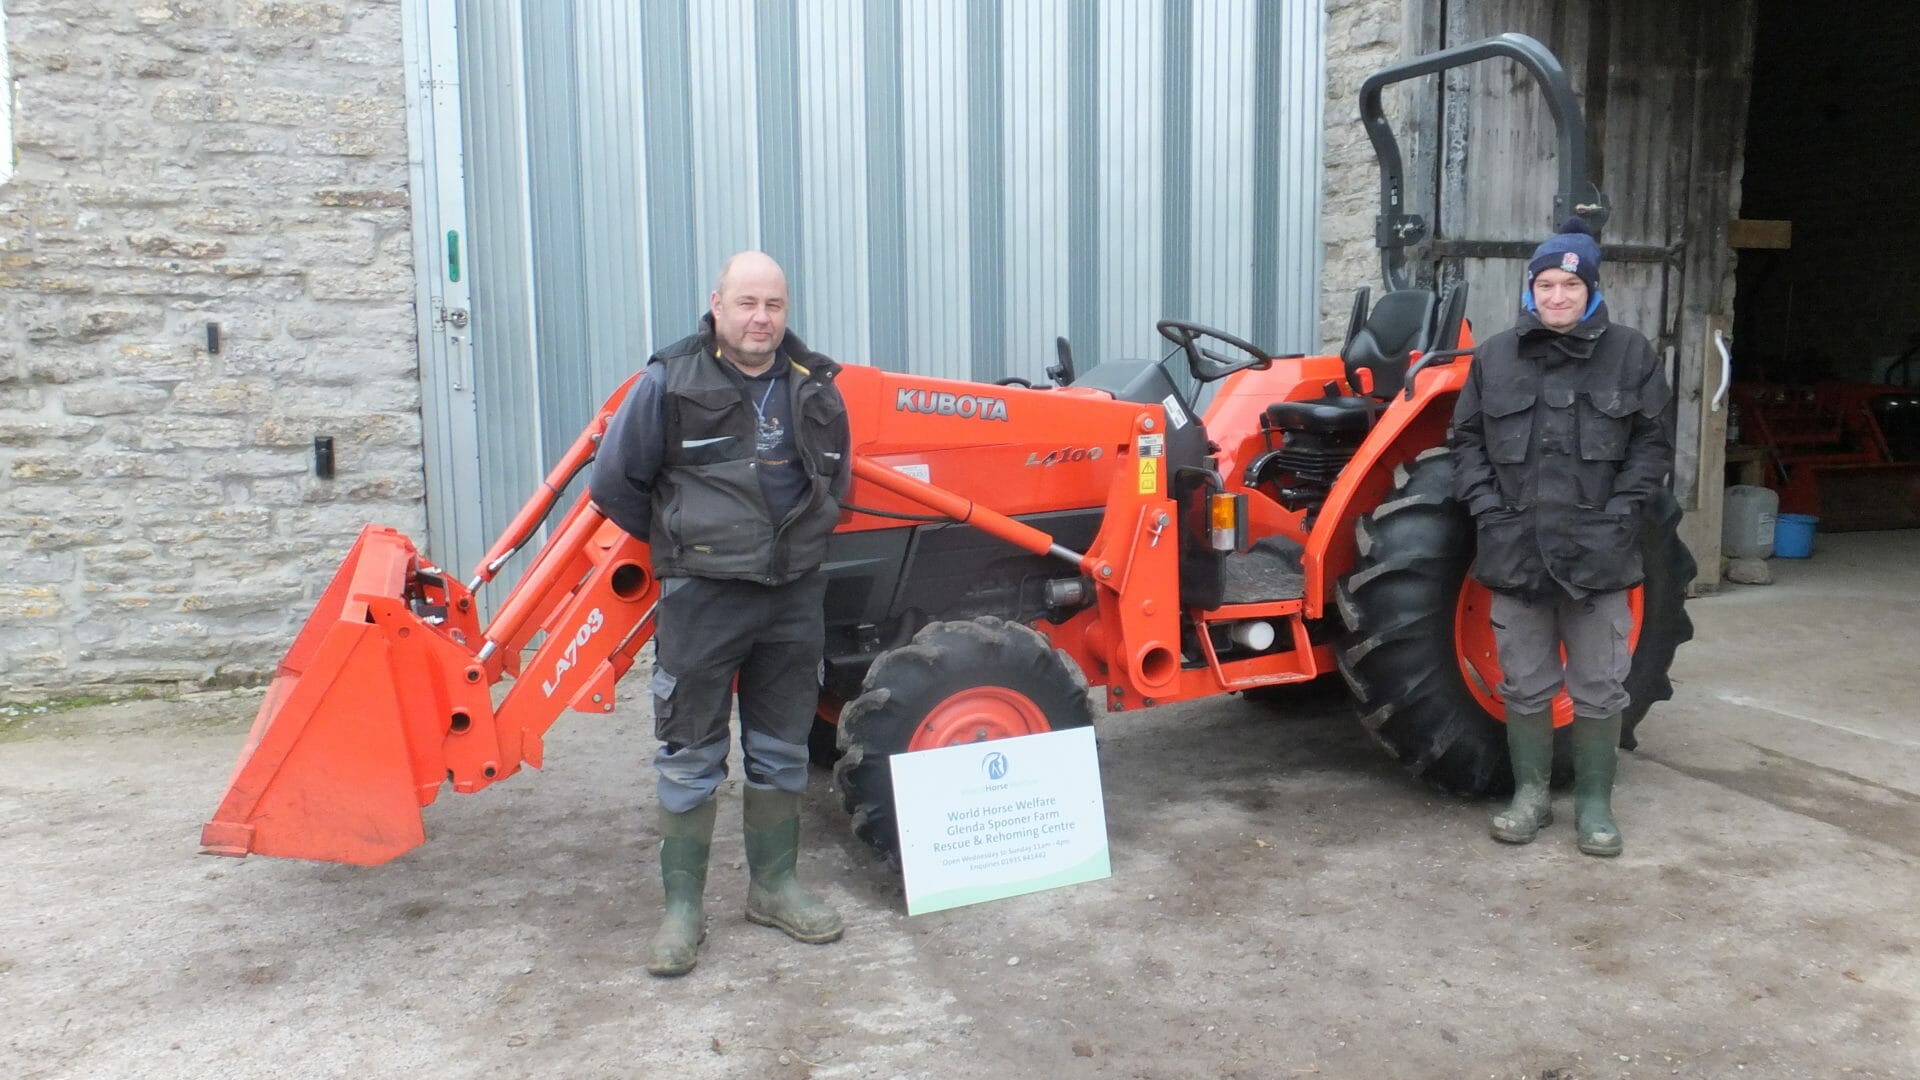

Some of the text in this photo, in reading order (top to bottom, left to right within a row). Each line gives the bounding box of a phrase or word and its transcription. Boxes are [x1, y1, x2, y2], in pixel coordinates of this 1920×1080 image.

[896, 388, 1008, 422] KUBOTA
[1025, 446, 1103, 467] L4100
[542, 608, 604, 698] LA703
[985, 783, 1008, 792] Horse
[947, 796, 1056, 821] World Horse Welfare
[947, 810, 1060, 836] Glenda Spooner Farm
[933, 821, 1076, 853] Rescue & Rehoming Centre
[942, 858, 961, 867] Open
[961, 851, 999, 863] Wednesday
[1008, 845, 1032, 856] Sunday
